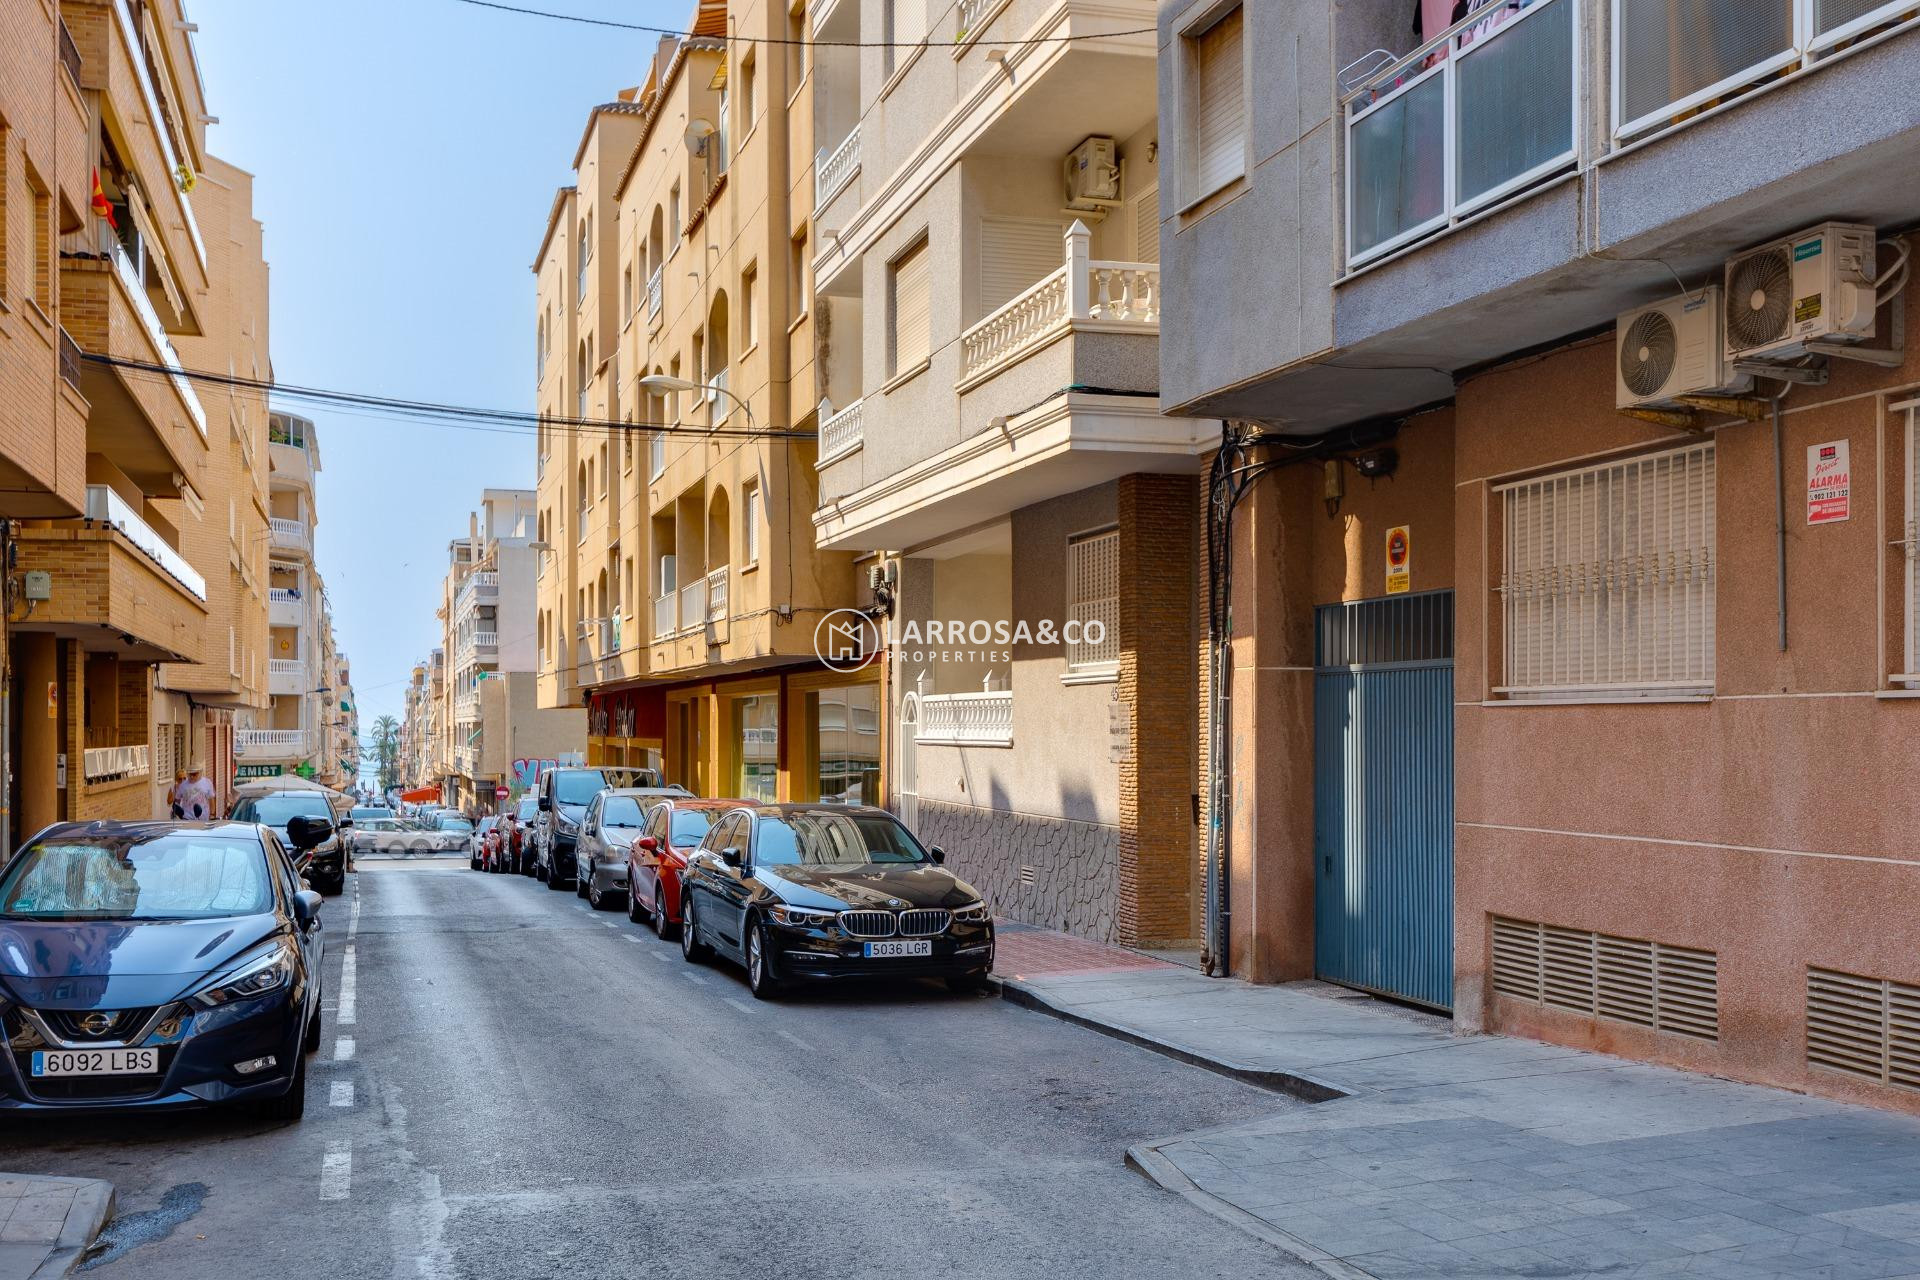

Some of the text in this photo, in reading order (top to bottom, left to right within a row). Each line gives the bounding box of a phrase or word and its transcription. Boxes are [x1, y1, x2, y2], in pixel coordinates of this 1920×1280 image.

[1809, 473, 1848, 489] ALARMA
[1826, 491, 1836, 499] 121
[1838, 489, 1848, 497] 122
[873, 942, 928, 955] 5036 LGR
[48, 1053, 103, 1073] 6092
[111, 1051, 152, 1070] LBS
